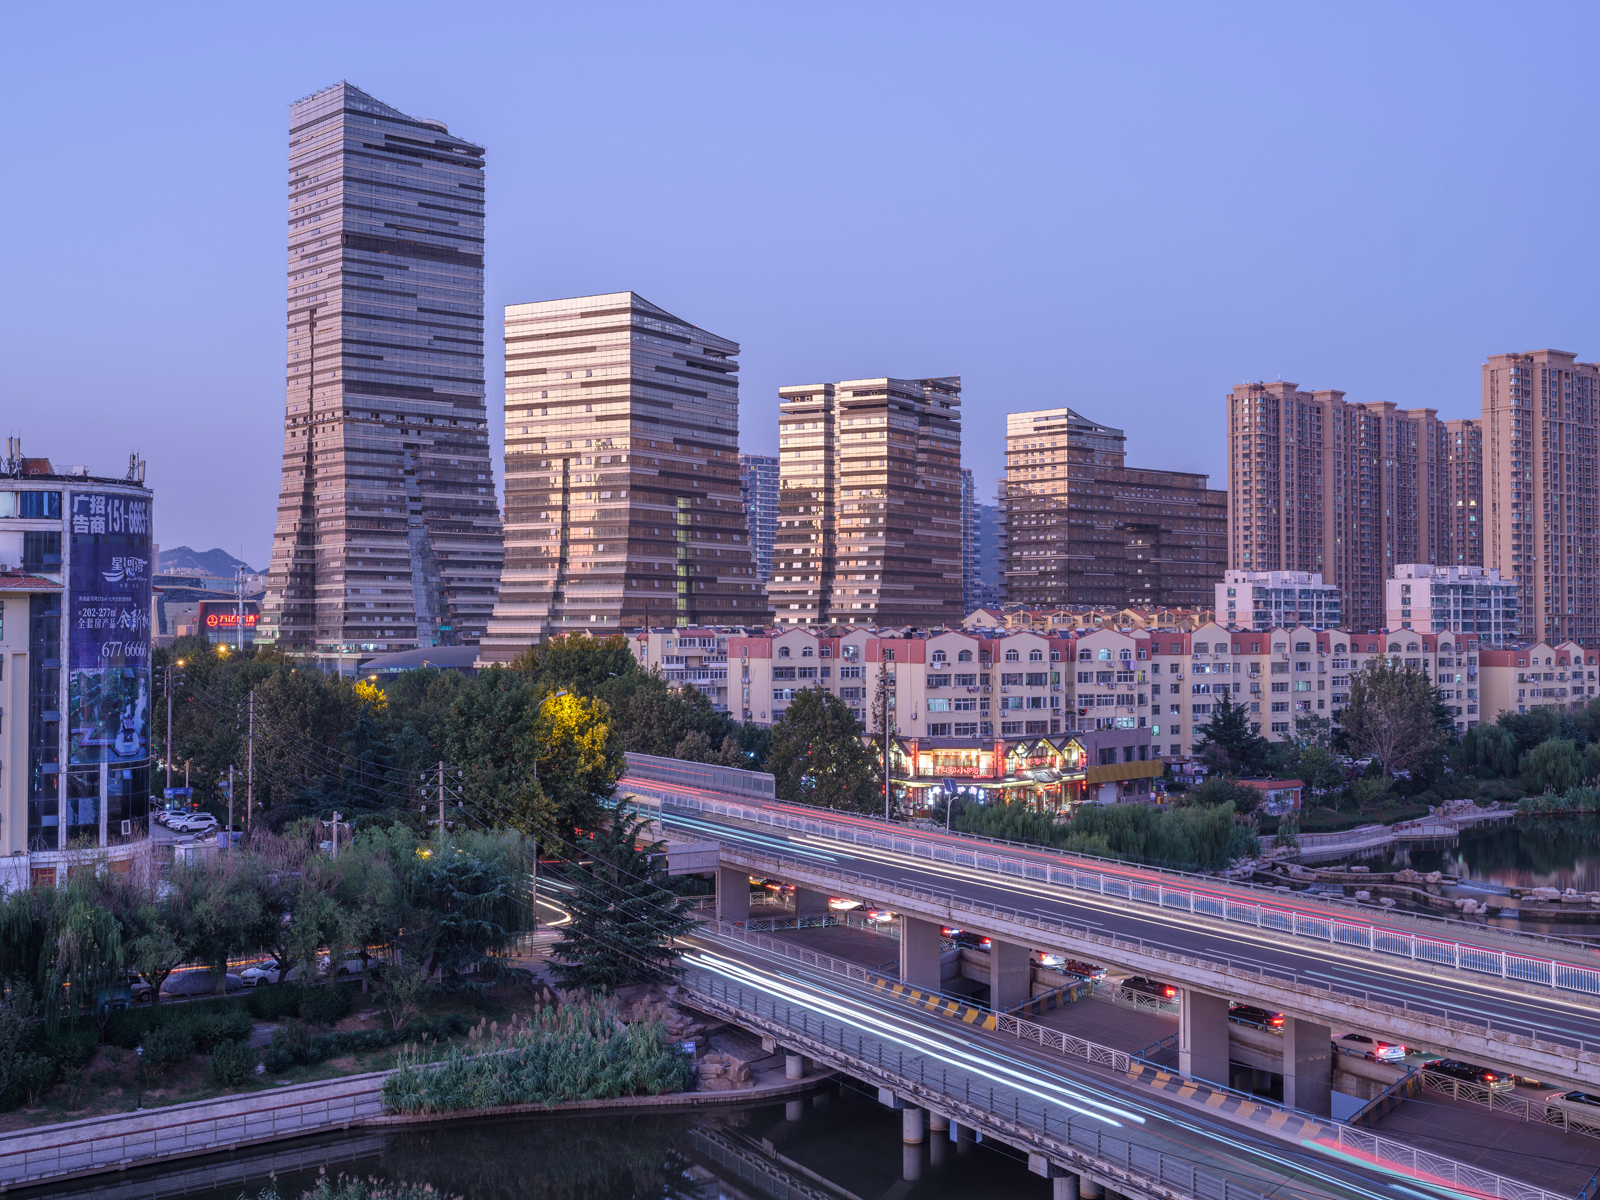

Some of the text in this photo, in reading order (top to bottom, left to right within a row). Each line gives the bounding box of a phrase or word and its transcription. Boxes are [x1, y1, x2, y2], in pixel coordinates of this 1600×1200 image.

[112, 556, 147, 572] 星河湾
[78, 617, 116, 629] 全套房产品
[102, 641, 122, 657] 677
